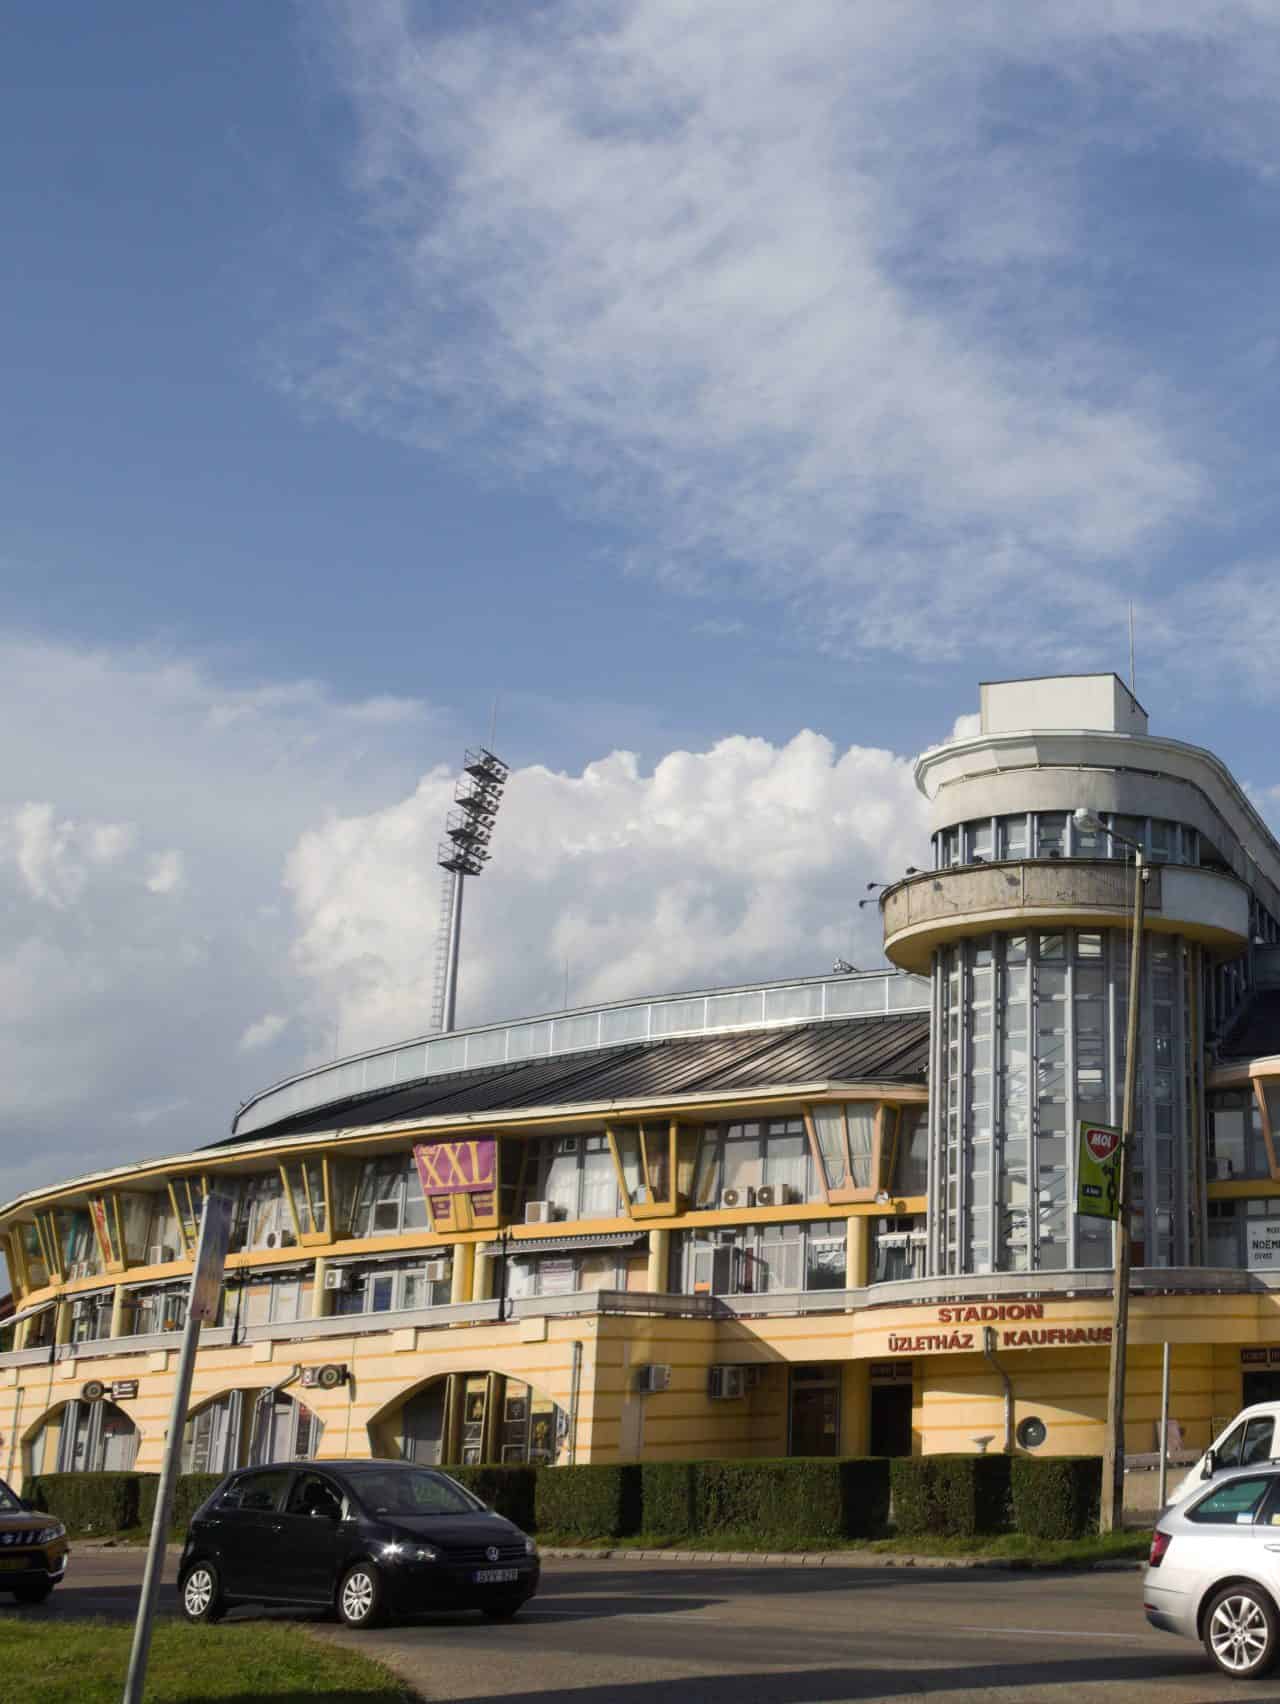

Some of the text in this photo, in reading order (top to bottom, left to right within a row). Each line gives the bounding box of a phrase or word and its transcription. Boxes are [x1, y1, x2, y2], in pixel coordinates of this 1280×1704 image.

[1090, 1133, 1112, 1149] MOL
[421, 1142, 493, 1187] XXL
[938, 1303, 1044, 1323] STADION
[888, 1330, 974, 1352] ÜZLETHÁZ
